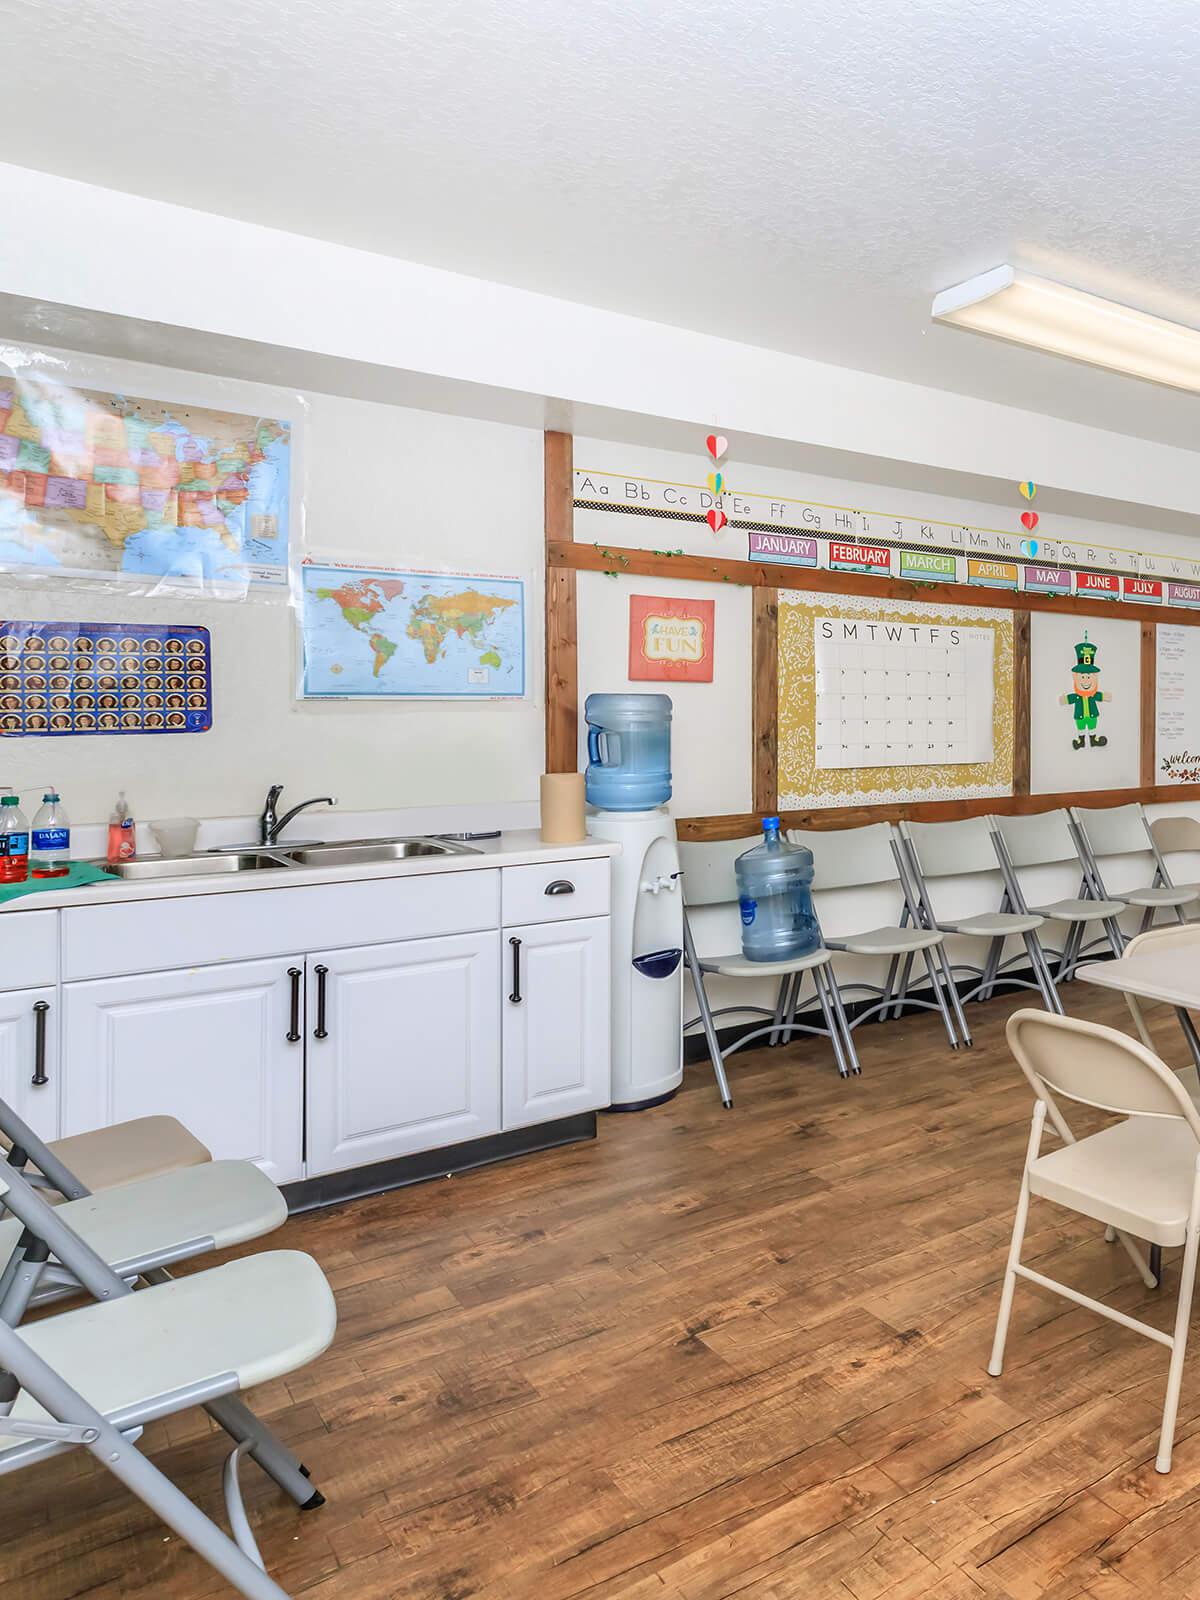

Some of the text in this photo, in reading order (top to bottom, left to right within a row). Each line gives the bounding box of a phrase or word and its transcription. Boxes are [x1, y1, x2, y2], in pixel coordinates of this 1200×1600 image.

[580, 477, 609, 495] Aa
[624, 482, 650, 500] Bb
[663, 488, 688, 505] Cc
[700, 493, 723, 510] Dd
[733, 498, 751, 514] Ee
[770, 503, 786, 518] Ff
[802, 508, 821, 529] Gg
[835, 513, 852, 528] Hh
[862, 516, 870, 531] Ii
[892, 521, 903, 539] Jj
[920, 525, 934, 540] Kk
[951, 529, 962, 543] Ll
[969, 533, 989, 546] Mm
[996, 536, 1012, 550] Nn
[1043, 543, 1055, 559] Pp
[1062, 546, 1077, 563] Qq
[1087, 549, 1097, 560] Rr
[1109, 552, 1117, 564] Ss
[1145, 558, 1155, 570] Uu
[1171, 562, 1181, 573] Vv
[755, 535, 811, 555] JANUARY
[832, 545, 888, 564] FEBRUARY
[905, 555, 951, 571] MARCH
[977, 563, 1009, 578] APRIL
[1036, 570, 1062, 583] MAY
[1085, 576, 1111, 588] JUNE
[1131, 581, 1156, 594] JULY
[1174, 587, 1200, 599] AUGUST
[660, 626, 688, 636] HAVE
[822, 622, 960, 645] S M T W T F S
[653, 637, 697, 655] FUN
[39, 831, 67, 839] DASANI
